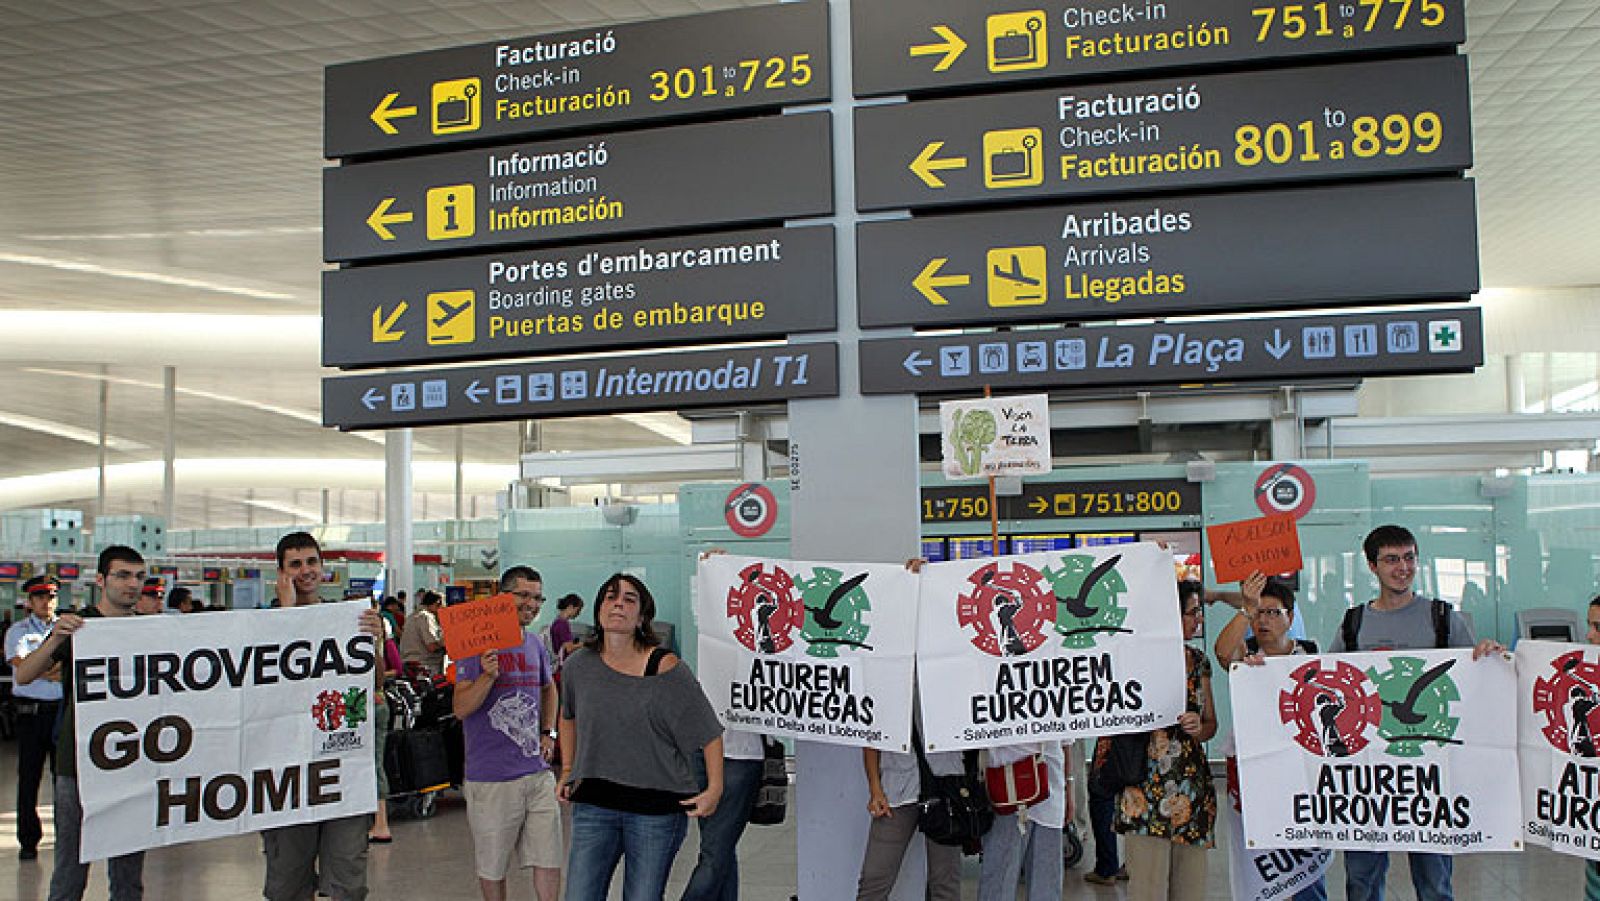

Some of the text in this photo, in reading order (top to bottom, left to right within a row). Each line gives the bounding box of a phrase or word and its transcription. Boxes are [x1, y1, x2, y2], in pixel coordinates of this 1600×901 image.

[1064, 1, 1167, 29] Check-in
[1066, 0, 1445, 59] Facturación 751 to a 775
[496, 31, 616, 67] Facturació
[495, 67, 580, 93] Check-in
[496, 54, 813, 121] Facturación 301 to a 725
[1058, 84, 1200, 120] Facturació
[1059, 120, 1160, 149] Check-in
[1060, 105, 1443, 181] Facturación 801 to a 899
[489, 141, 608, 177] Informació
[490, 174, 598, 203] Information
[489, 196, 624, 232] Información
[1062, 208, 1192, 239] Arribades
[489, 238, 781, 285] Portes d'embarcament
[1064, 242, 1151, 268] Arrivals
[489, 280, 636, 310] Boarding gates
[1065, 270, 1185, 303] Llegadas
[489, 299, 766, 338] Puertas de embarque
[1096, 331, 1244, 372] La Plaça
[595, 354, 810, 399] Intermodal T1
[76, 635, 376, 703] EUROVEGAS
[751, 659, 850, 694] ATUREM
[995, 653, 1112, 694] ATUREM
[731, 682, 873, 725] EUROVEGAS
[971, 679, 1143, 724] EUROVEGAS
[89, 715, 193, 771] GO
[963, 712, 1155, 741] Salvem el Delta del Llobregat
[156, 758, 342, 827] HOME
[1317, 763, 1440, 799] ATUREM
[1558, 761, 1600, 799] AT
[1293, 794, 1470, 829] EUROVEGAS
[1284, 828, 1483, 847] Salvem el Delta del Llobregat
